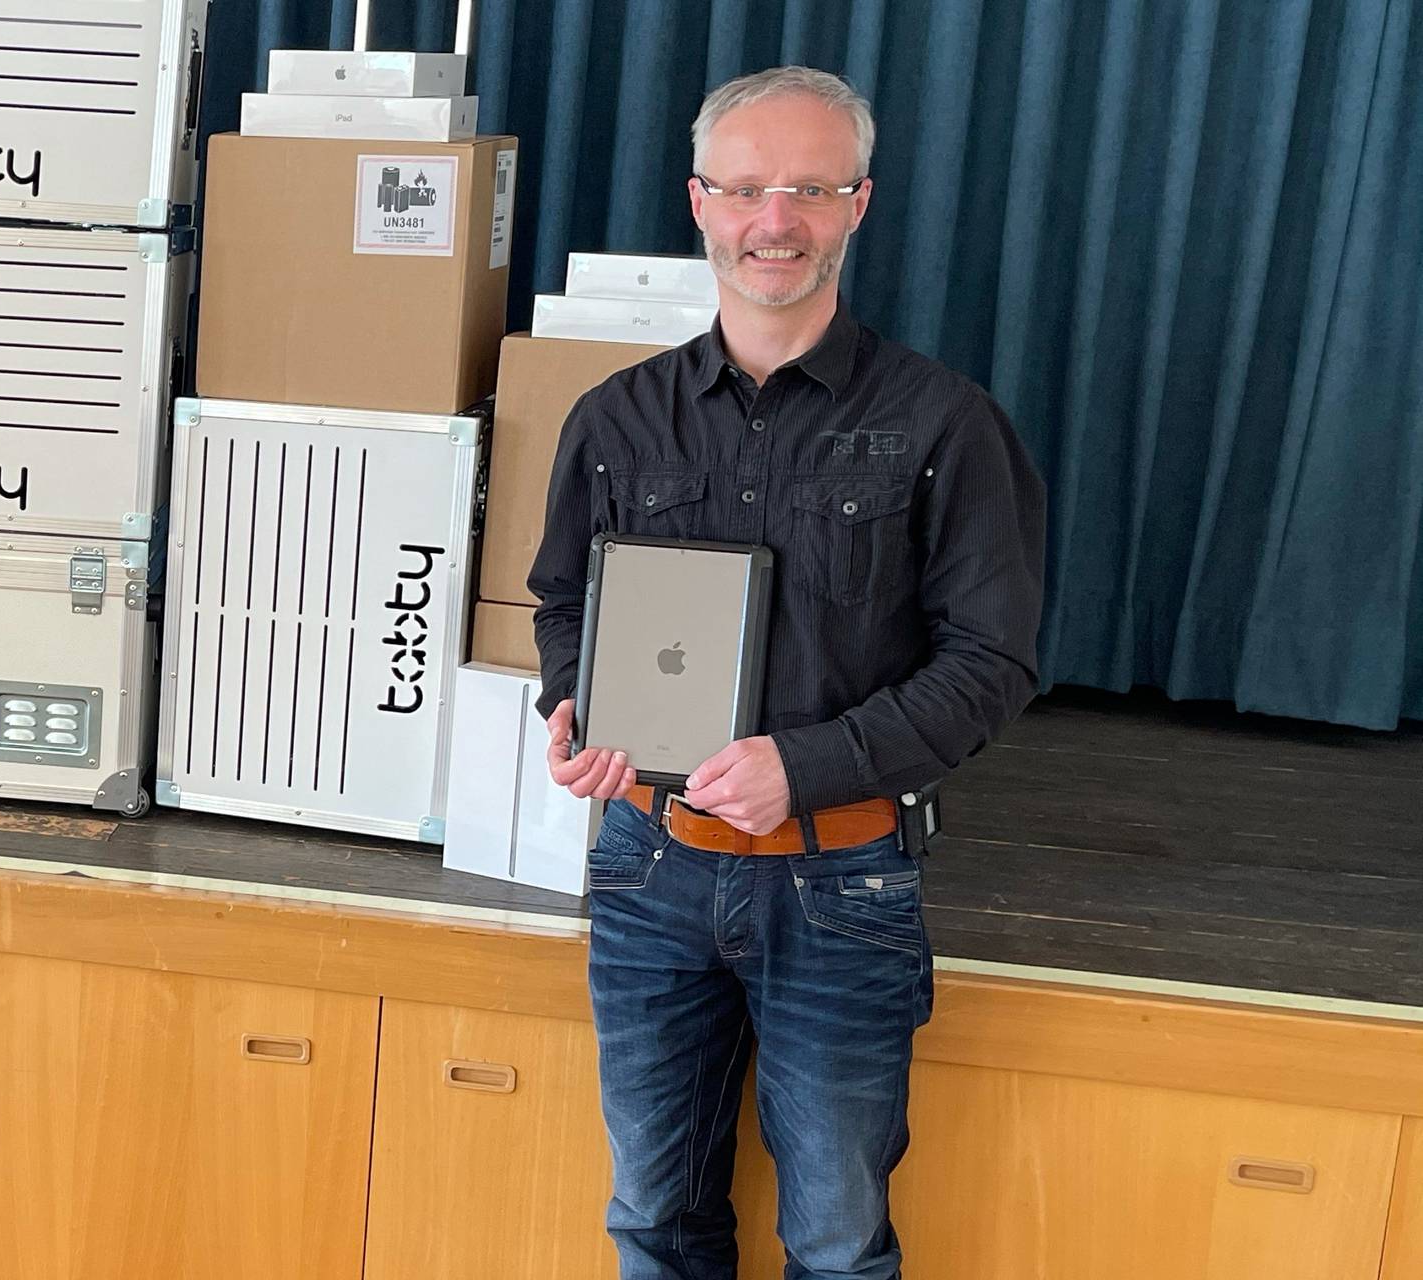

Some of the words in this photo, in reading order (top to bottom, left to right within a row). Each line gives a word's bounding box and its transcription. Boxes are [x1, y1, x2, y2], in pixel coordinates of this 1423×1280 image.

[335, 113, 353, 122] iPad
[383, 216, 425, 228] UN3481
[632, 316, 651, 326] iPad
[376, 543, 447, 715] tabty
